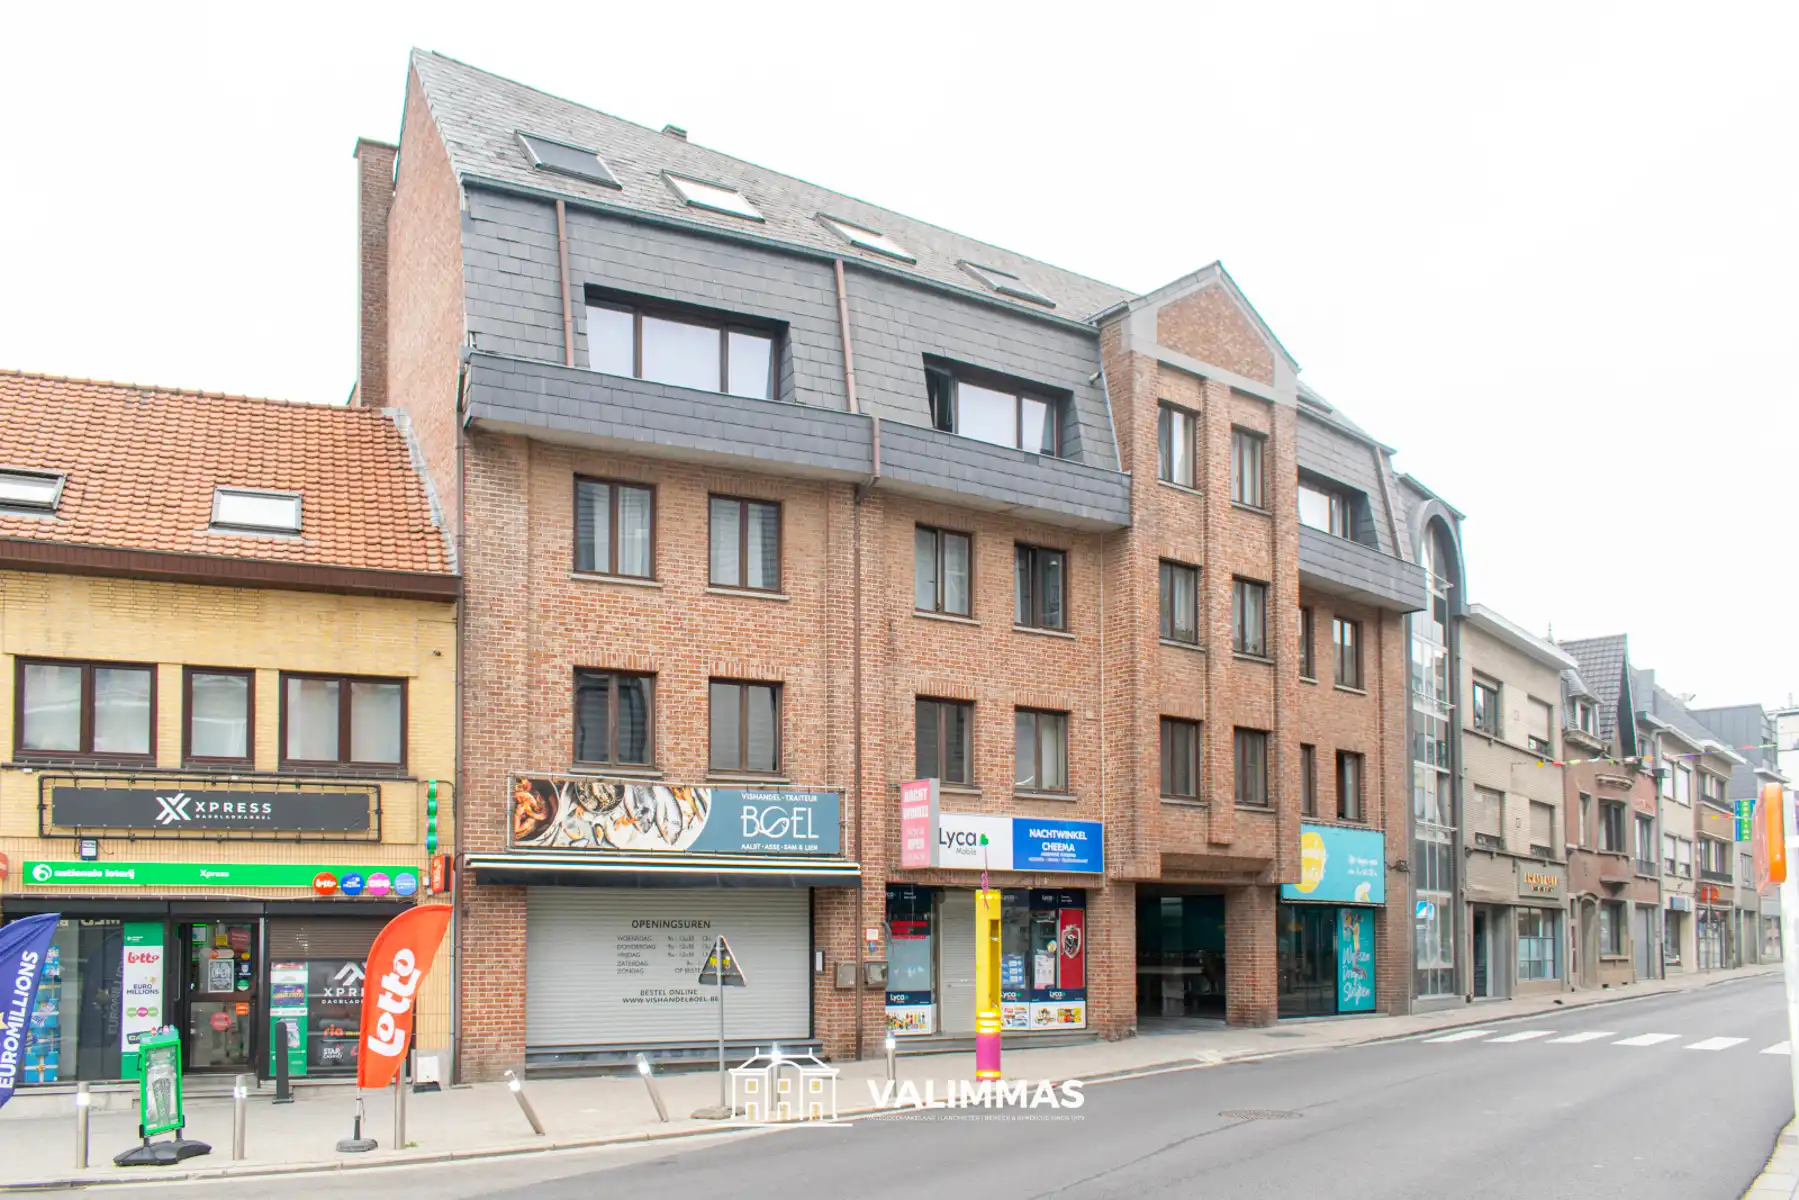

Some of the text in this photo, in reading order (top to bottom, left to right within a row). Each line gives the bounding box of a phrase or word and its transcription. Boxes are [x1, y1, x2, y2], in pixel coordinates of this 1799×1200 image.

[741, 792, 818, 802] VISHANDEL TRAITEUR
[195, 801, 272, 814] XPRESS
[741, 805, 819, 838] BOEL
[939, 827, 977, 849] Lyca
[1029, 828, 1088, 840] NACHTWINKEL
[1041, 841, 1076, 852] CHEEMA
[200, 869, 230, 878] Xpress
[631, 919, 711, 929] OPENINGSUREN
[127, 952, 160, 964] Lotto
[367, 948, 421, 1057] Lotto
[0, 951, 39, 1089] EUROMILLIONS
